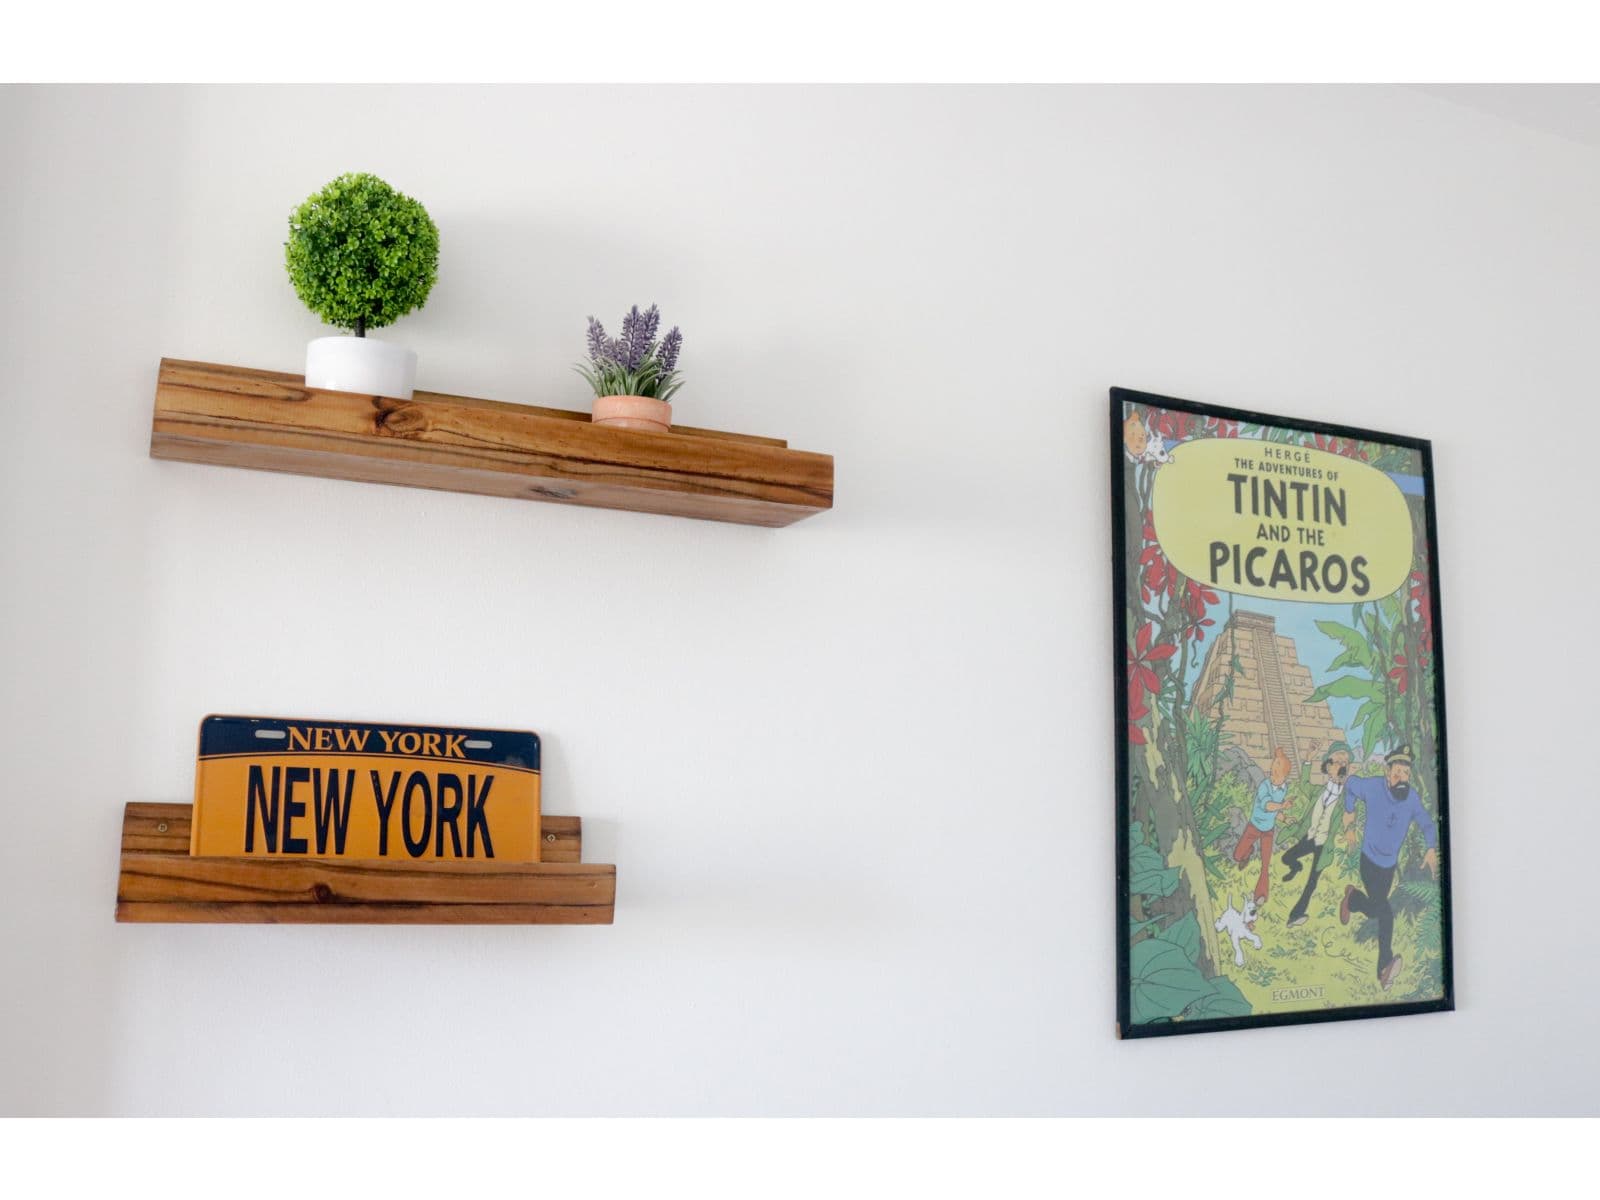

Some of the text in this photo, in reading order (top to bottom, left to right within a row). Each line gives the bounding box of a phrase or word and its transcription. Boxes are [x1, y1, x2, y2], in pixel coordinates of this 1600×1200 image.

[1234, 458, 1339, 482] THE ADVENTURES OF
[1227, 473, 1347, 527] TINTIN
[1256, 523, 1325, 547] AND THE
[1209, 541, 1371, 596] PICAROS
[287, 726, 469, 759] NEW YORK
[244, 765, 495, 859] NEW YORK
[1272, 987, 1324, 1001] EGMONT
